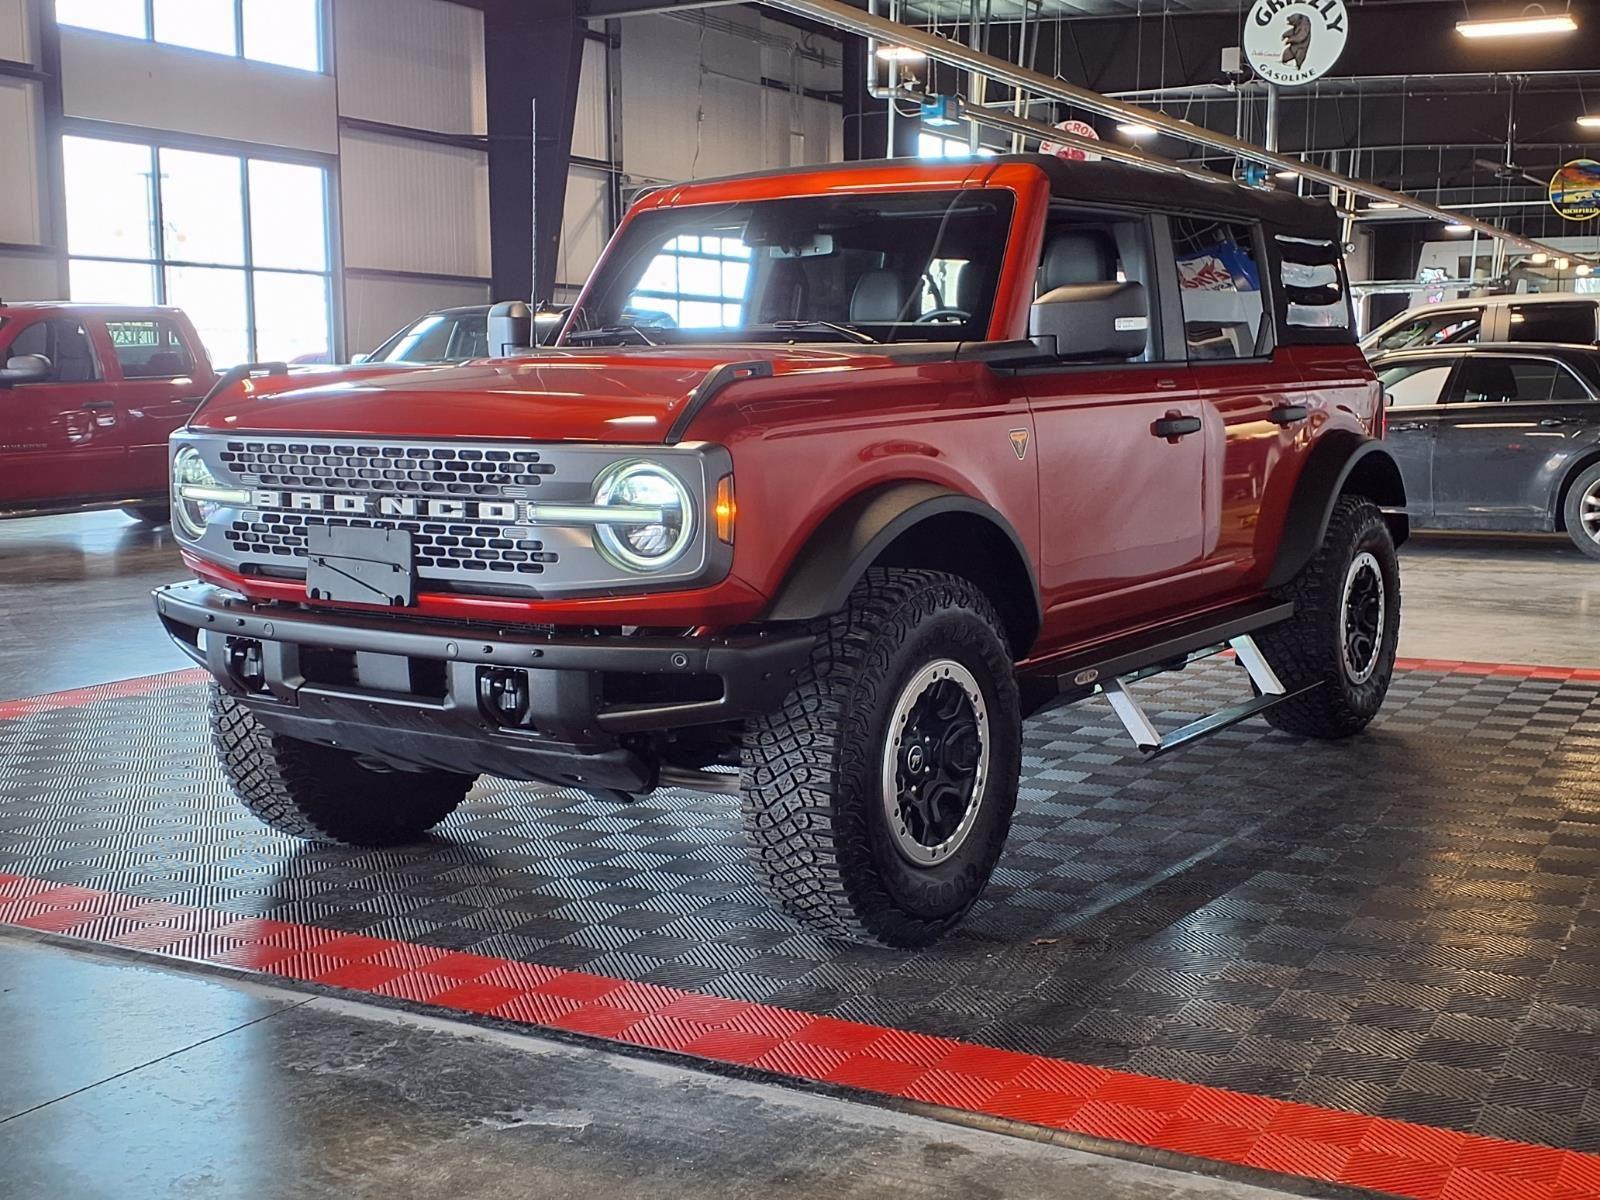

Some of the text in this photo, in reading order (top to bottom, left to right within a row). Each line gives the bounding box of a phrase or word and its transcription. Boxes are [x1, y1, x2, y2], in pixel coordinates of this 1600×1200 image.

[1255, 0, 1343, 32] GRLY
[1259, 63, 1316, 82] GASOLINE
[250, 490, 516, 521] BRONCO
